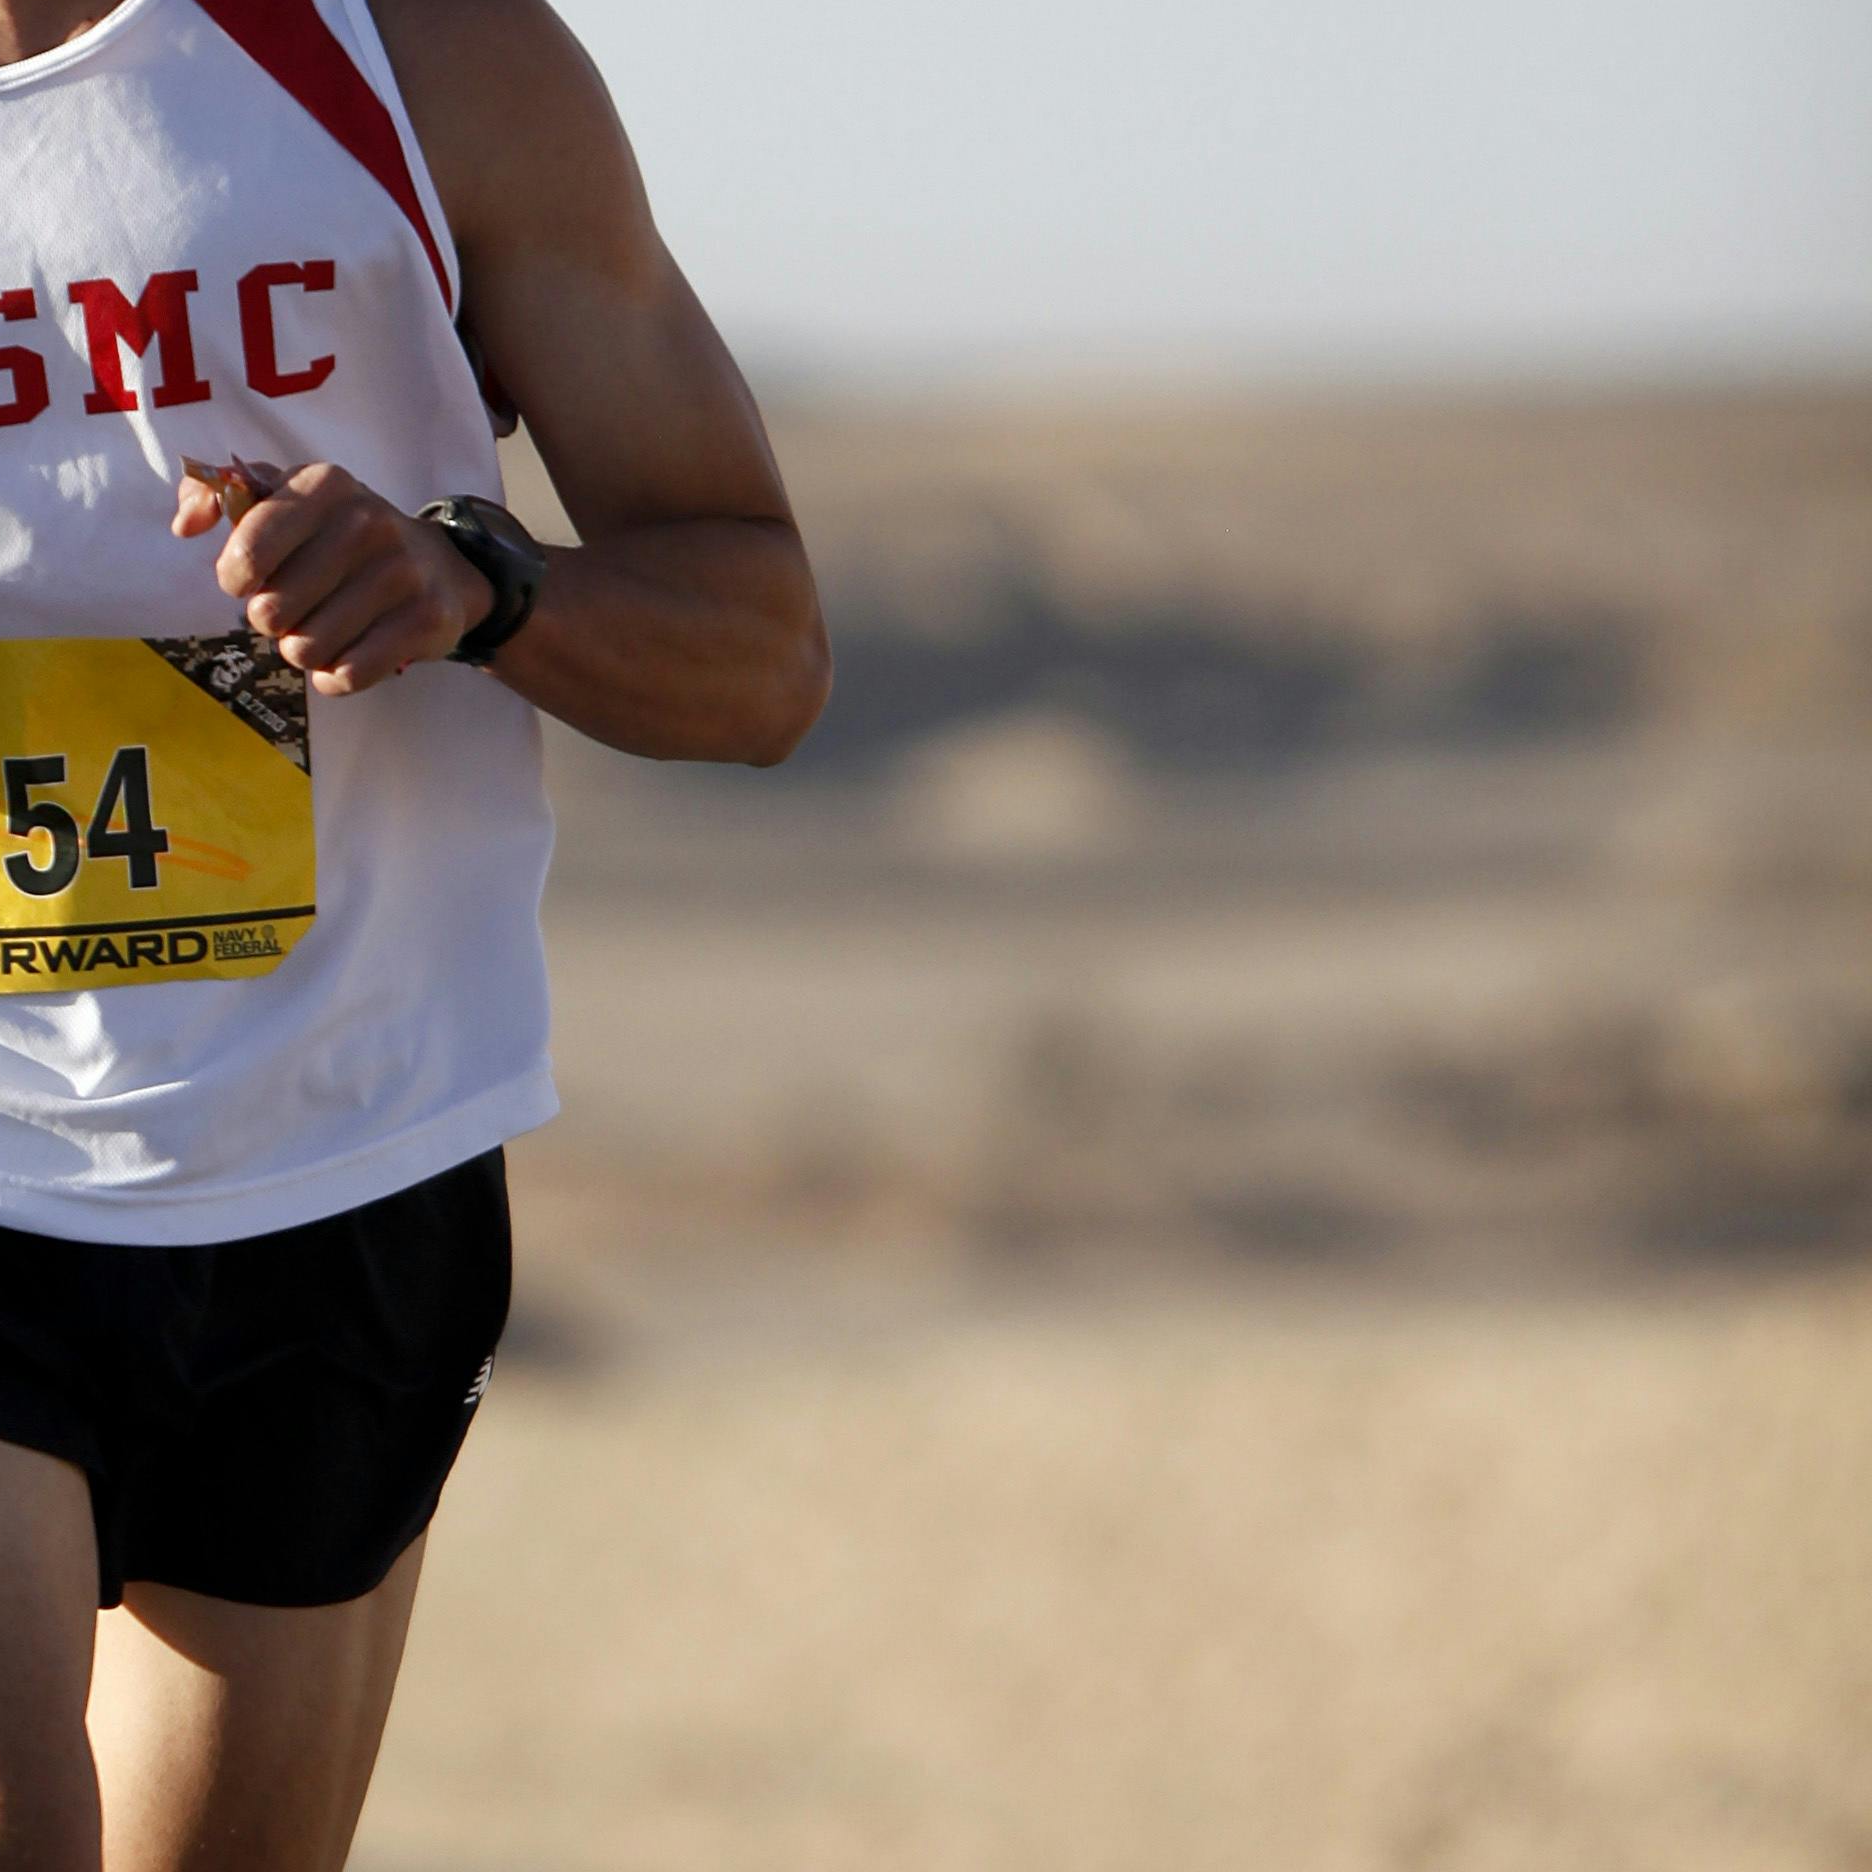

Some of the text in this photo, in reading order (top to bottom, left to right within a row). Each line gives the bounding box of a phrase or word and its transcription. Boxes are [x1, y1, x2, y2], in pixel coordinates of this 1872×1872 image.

[2, 745, 168, 898] 54
[213, 927, 256, 943] NAVY
[214, 939, 282, 957] FEDERAL
